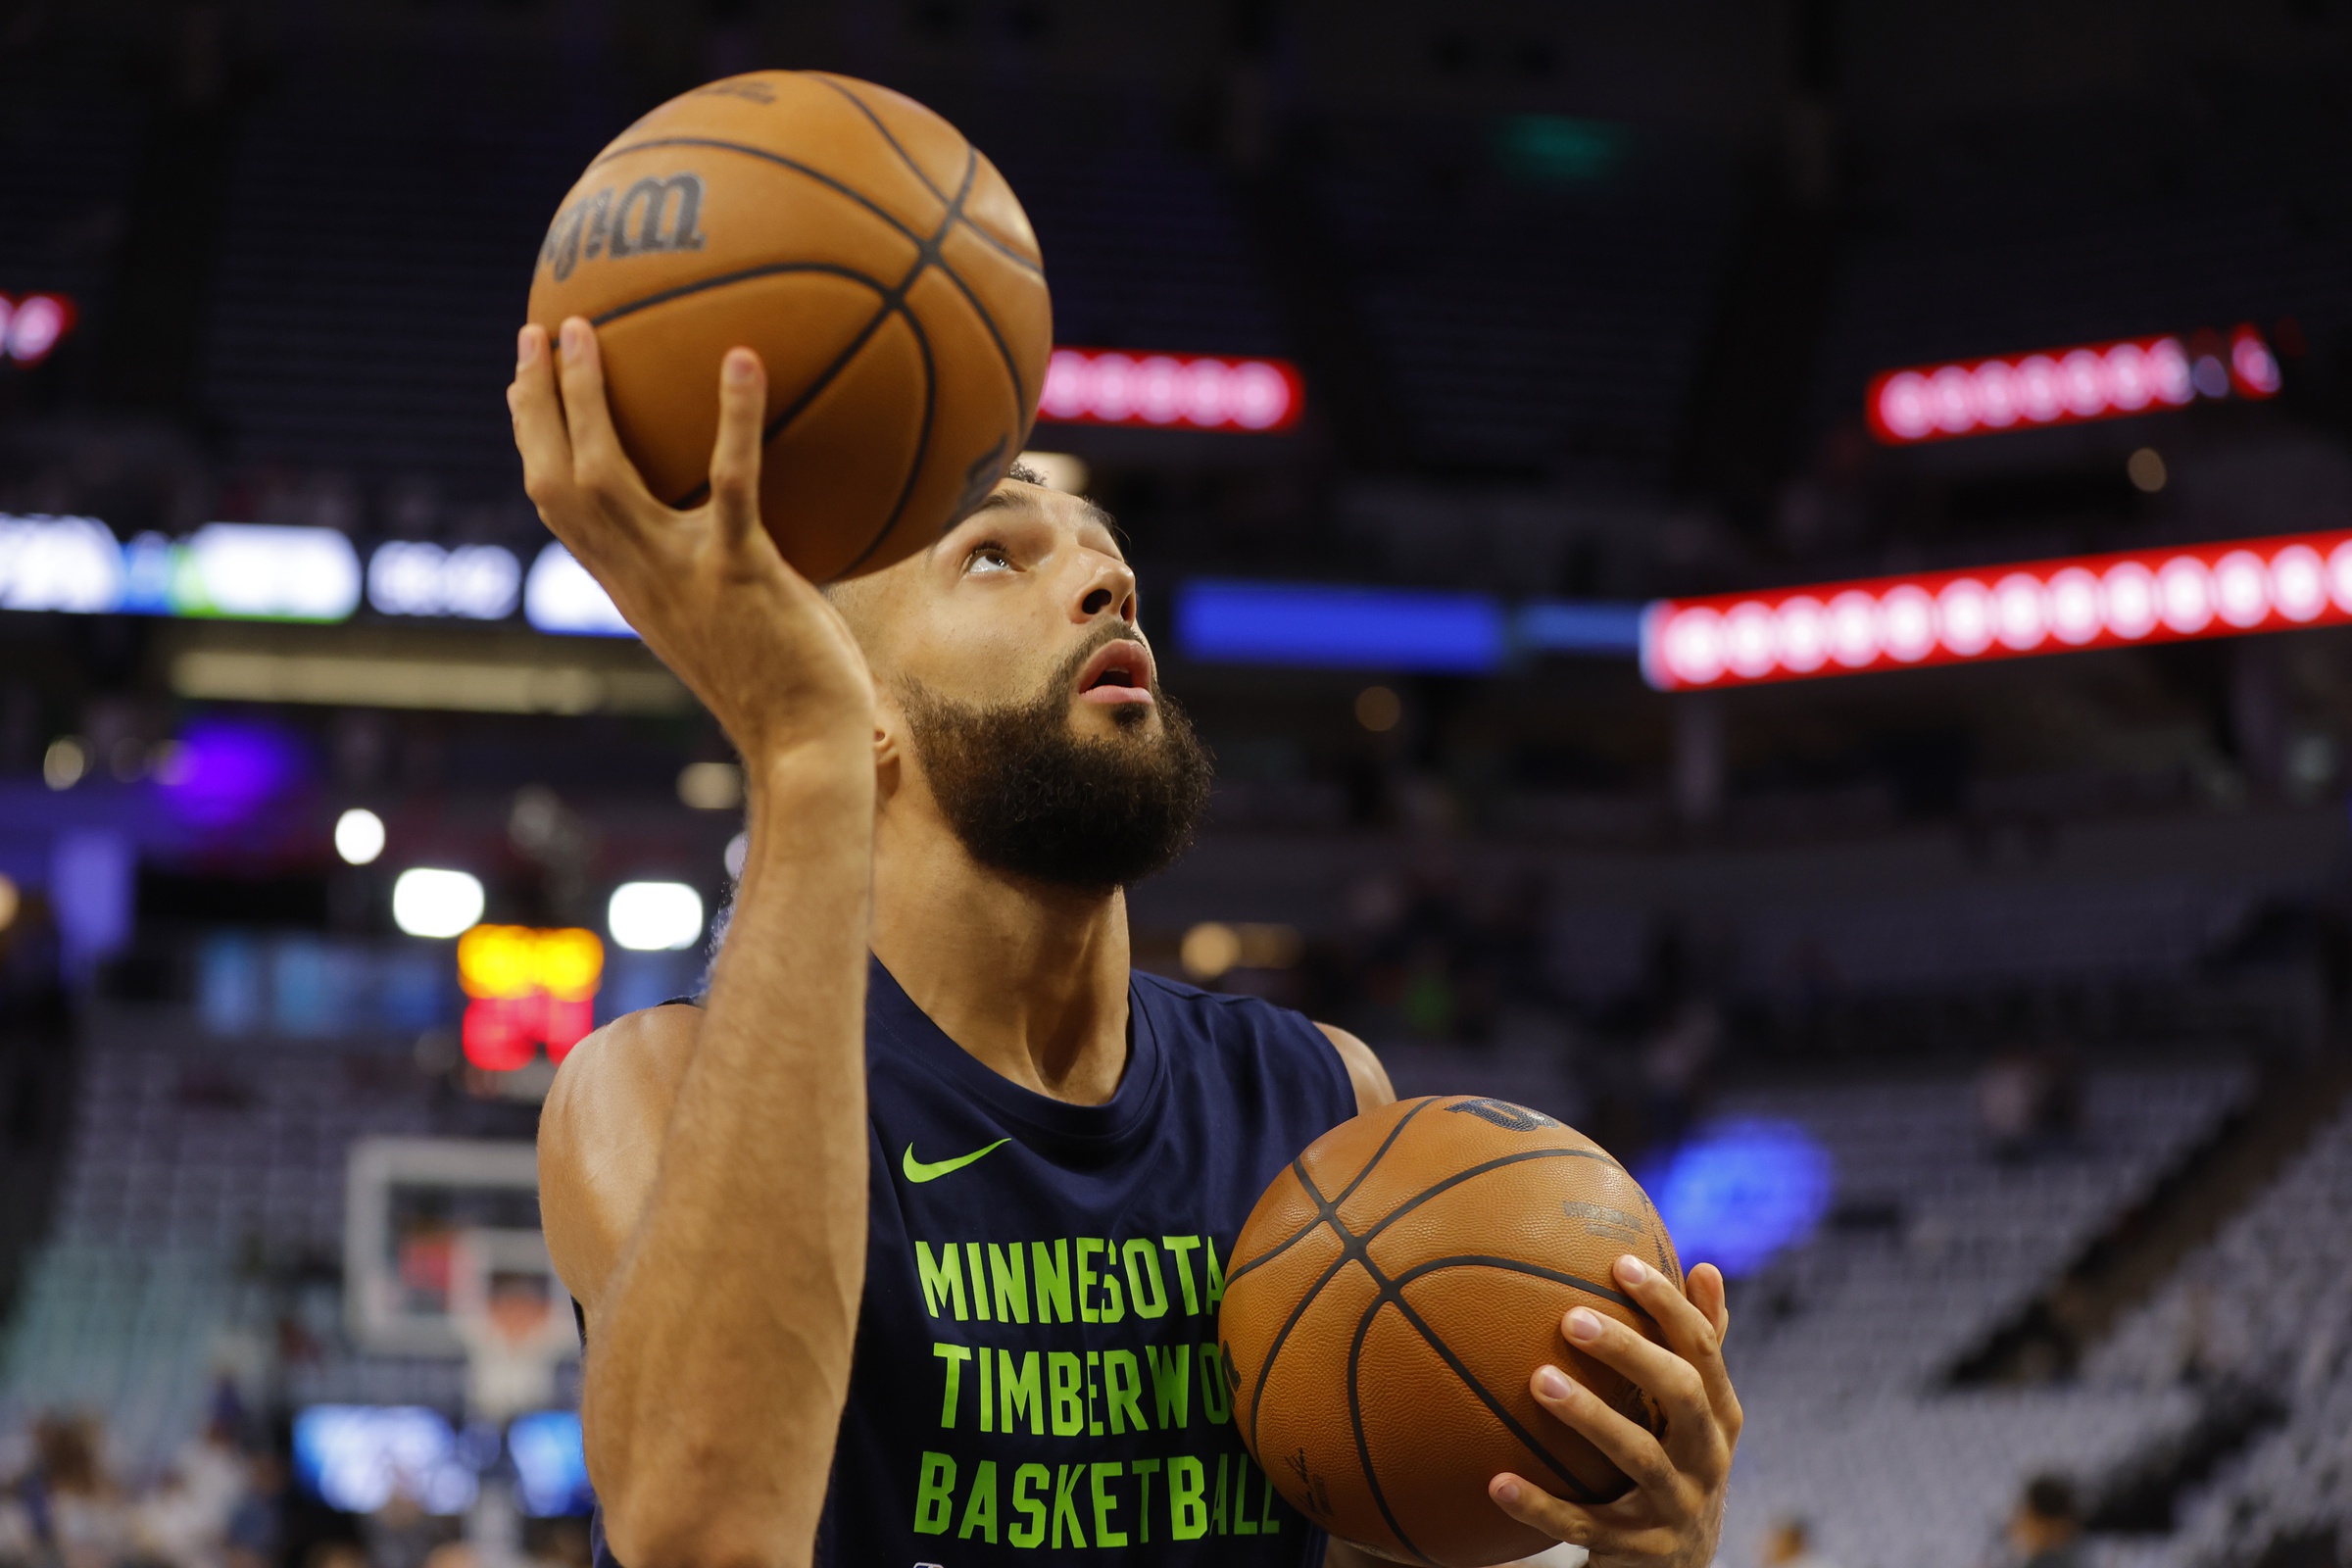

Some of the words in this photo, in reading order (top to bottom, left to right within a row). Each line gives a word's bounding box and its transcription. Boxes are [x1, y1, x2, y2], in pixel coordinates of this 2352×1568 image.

[542, 171, 707, 284] Wil
[914, 1235, 1226, 1324] MINNESOTA
[933, 1342, 1233, 1437] TIMBERWO
[913, 1450, 1281, 1549] BASKETBALL
